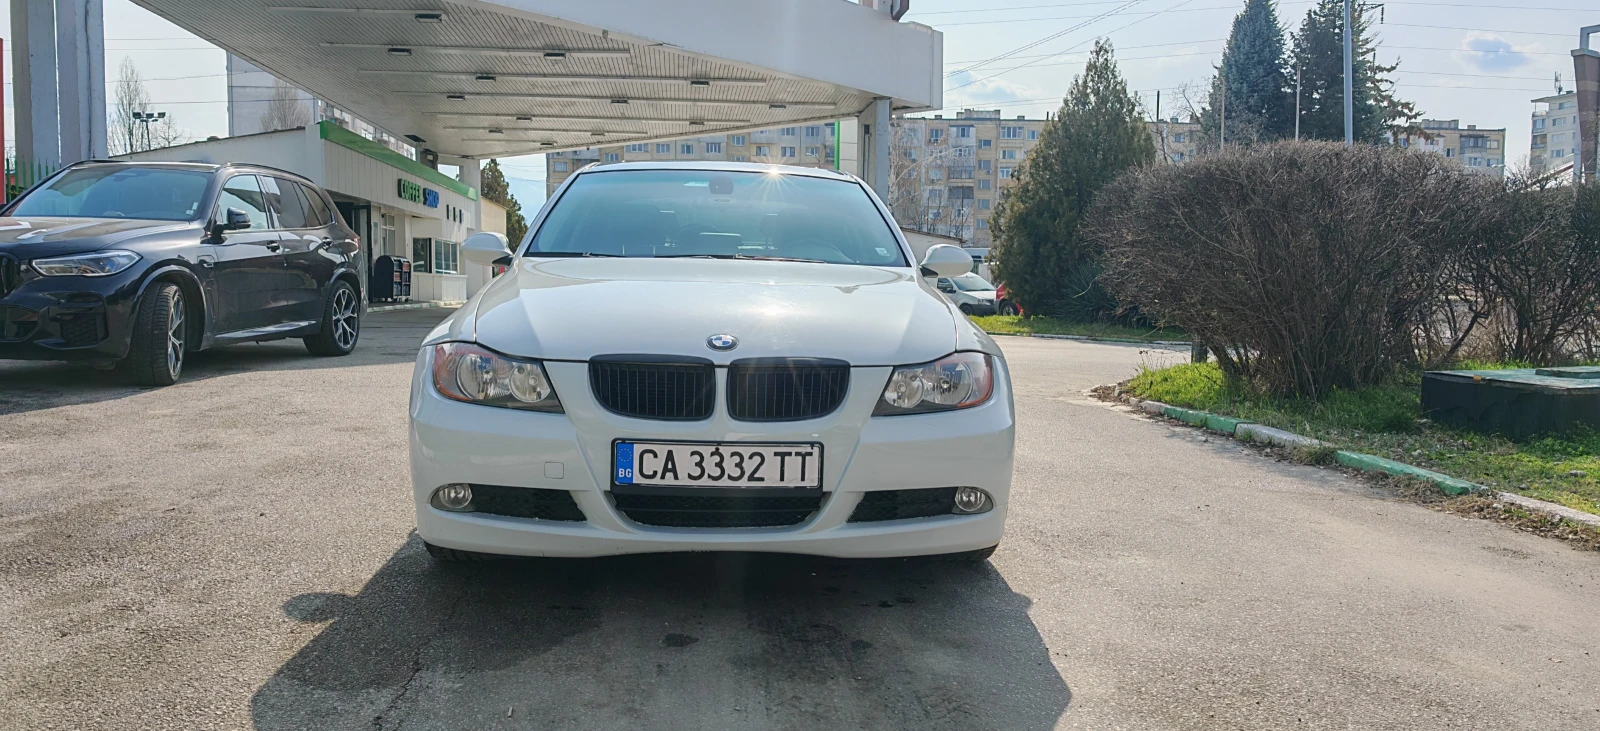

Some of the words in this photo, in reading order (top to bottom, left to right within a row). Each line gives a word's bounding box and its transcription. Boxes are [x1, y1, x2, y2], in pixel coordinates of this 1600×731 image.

[423, 188, 439, 208] SHOP
[618, 468, 632, 478] BG
[638, 448, 679, 480] CA
[687, 450, 766, 482] 3332
[773, 451, 813, 482] TT
